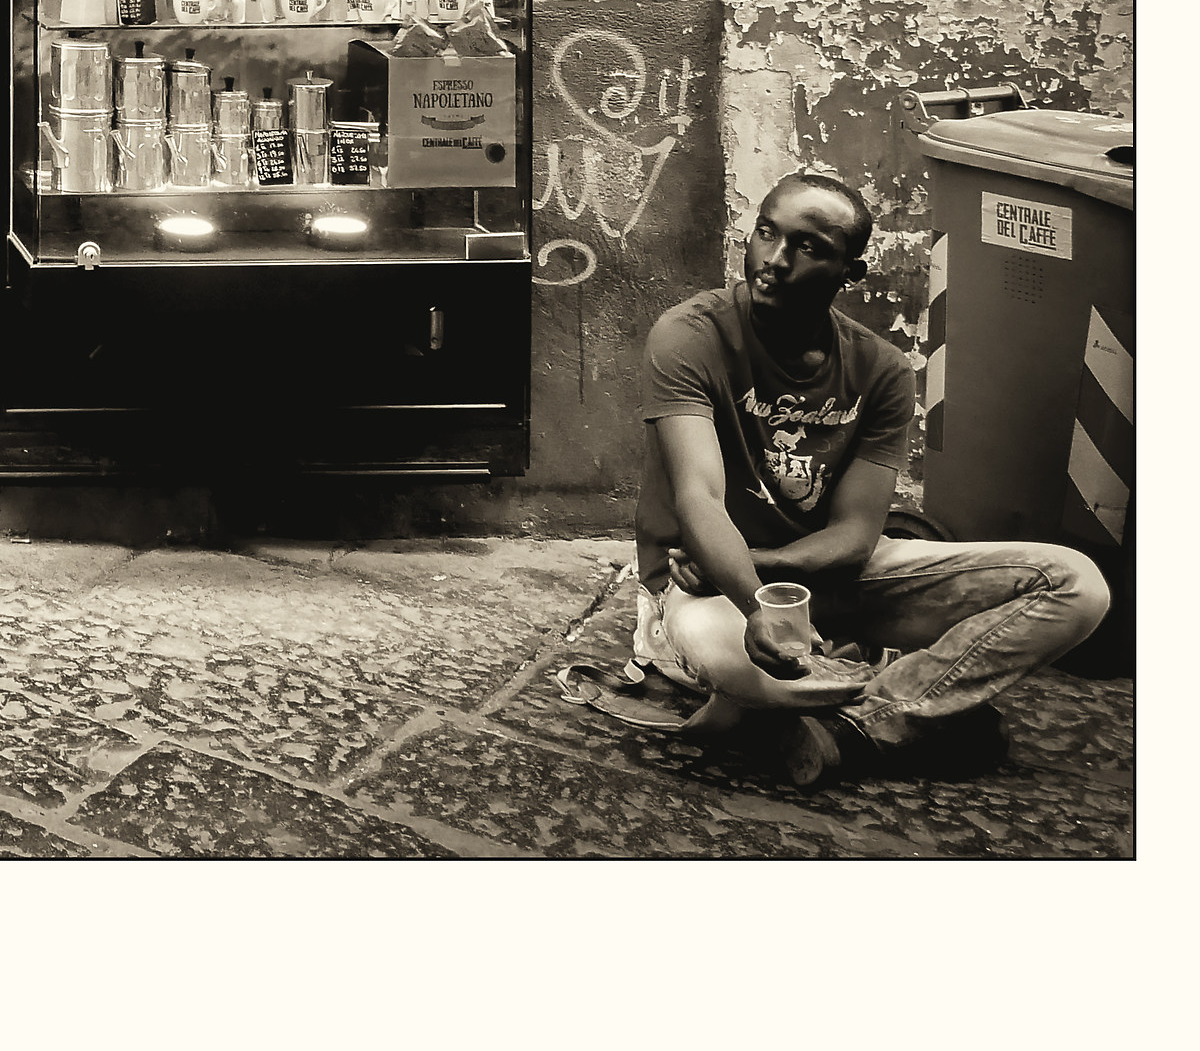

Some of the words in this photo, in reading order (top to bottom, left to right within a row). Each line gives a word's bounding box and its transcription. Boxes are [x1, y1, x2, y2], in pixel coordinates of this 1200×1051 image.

[432, 79, 474, 91] ESPRESSO
[412, 92, 494, 108] NAPOLETANO
[422, 137, 452, 148] CENTRALE
[996, 201, 1052, 227] CENTRALE
[997, 219, 1016, 238] DEL
[768, 394, 862, 426] Zealand
